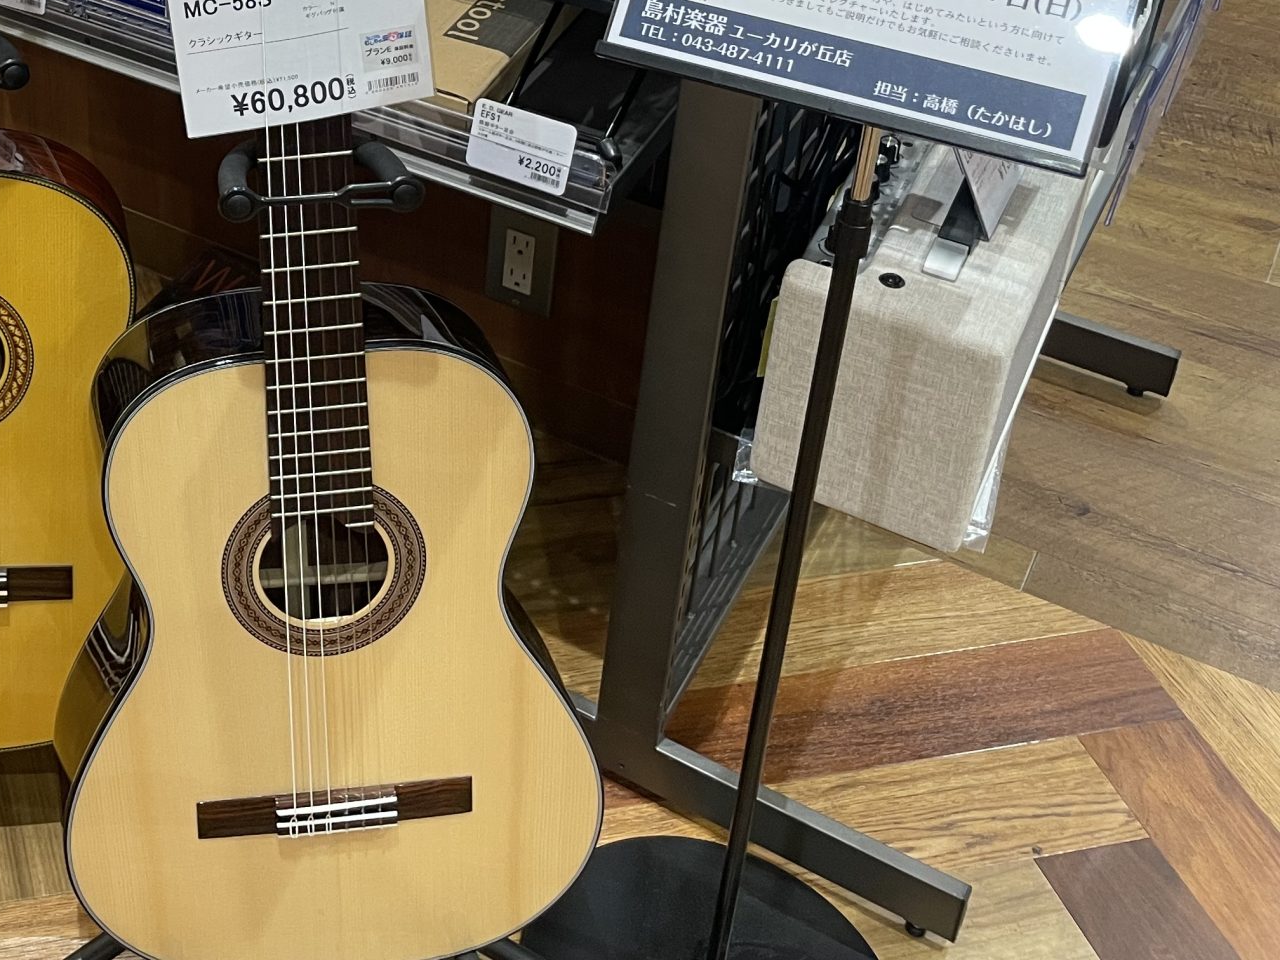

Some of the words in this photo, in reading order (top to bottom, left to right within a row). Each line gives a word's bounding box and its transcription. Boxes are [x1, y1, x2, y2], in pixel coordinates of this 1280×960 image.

[187, 30, 264, 50] クラシックギター
[641, 0, 729, 37] 島村楽器
[728, 24, 855, 68] ユーカリが丘店
[380, 54, 410, 67] ¥9,000
[230, 76, 346, 118] ¥60,800
[480, 109, 502, 123] EFS1
[517, 154, 557, 177] ¥2,200
